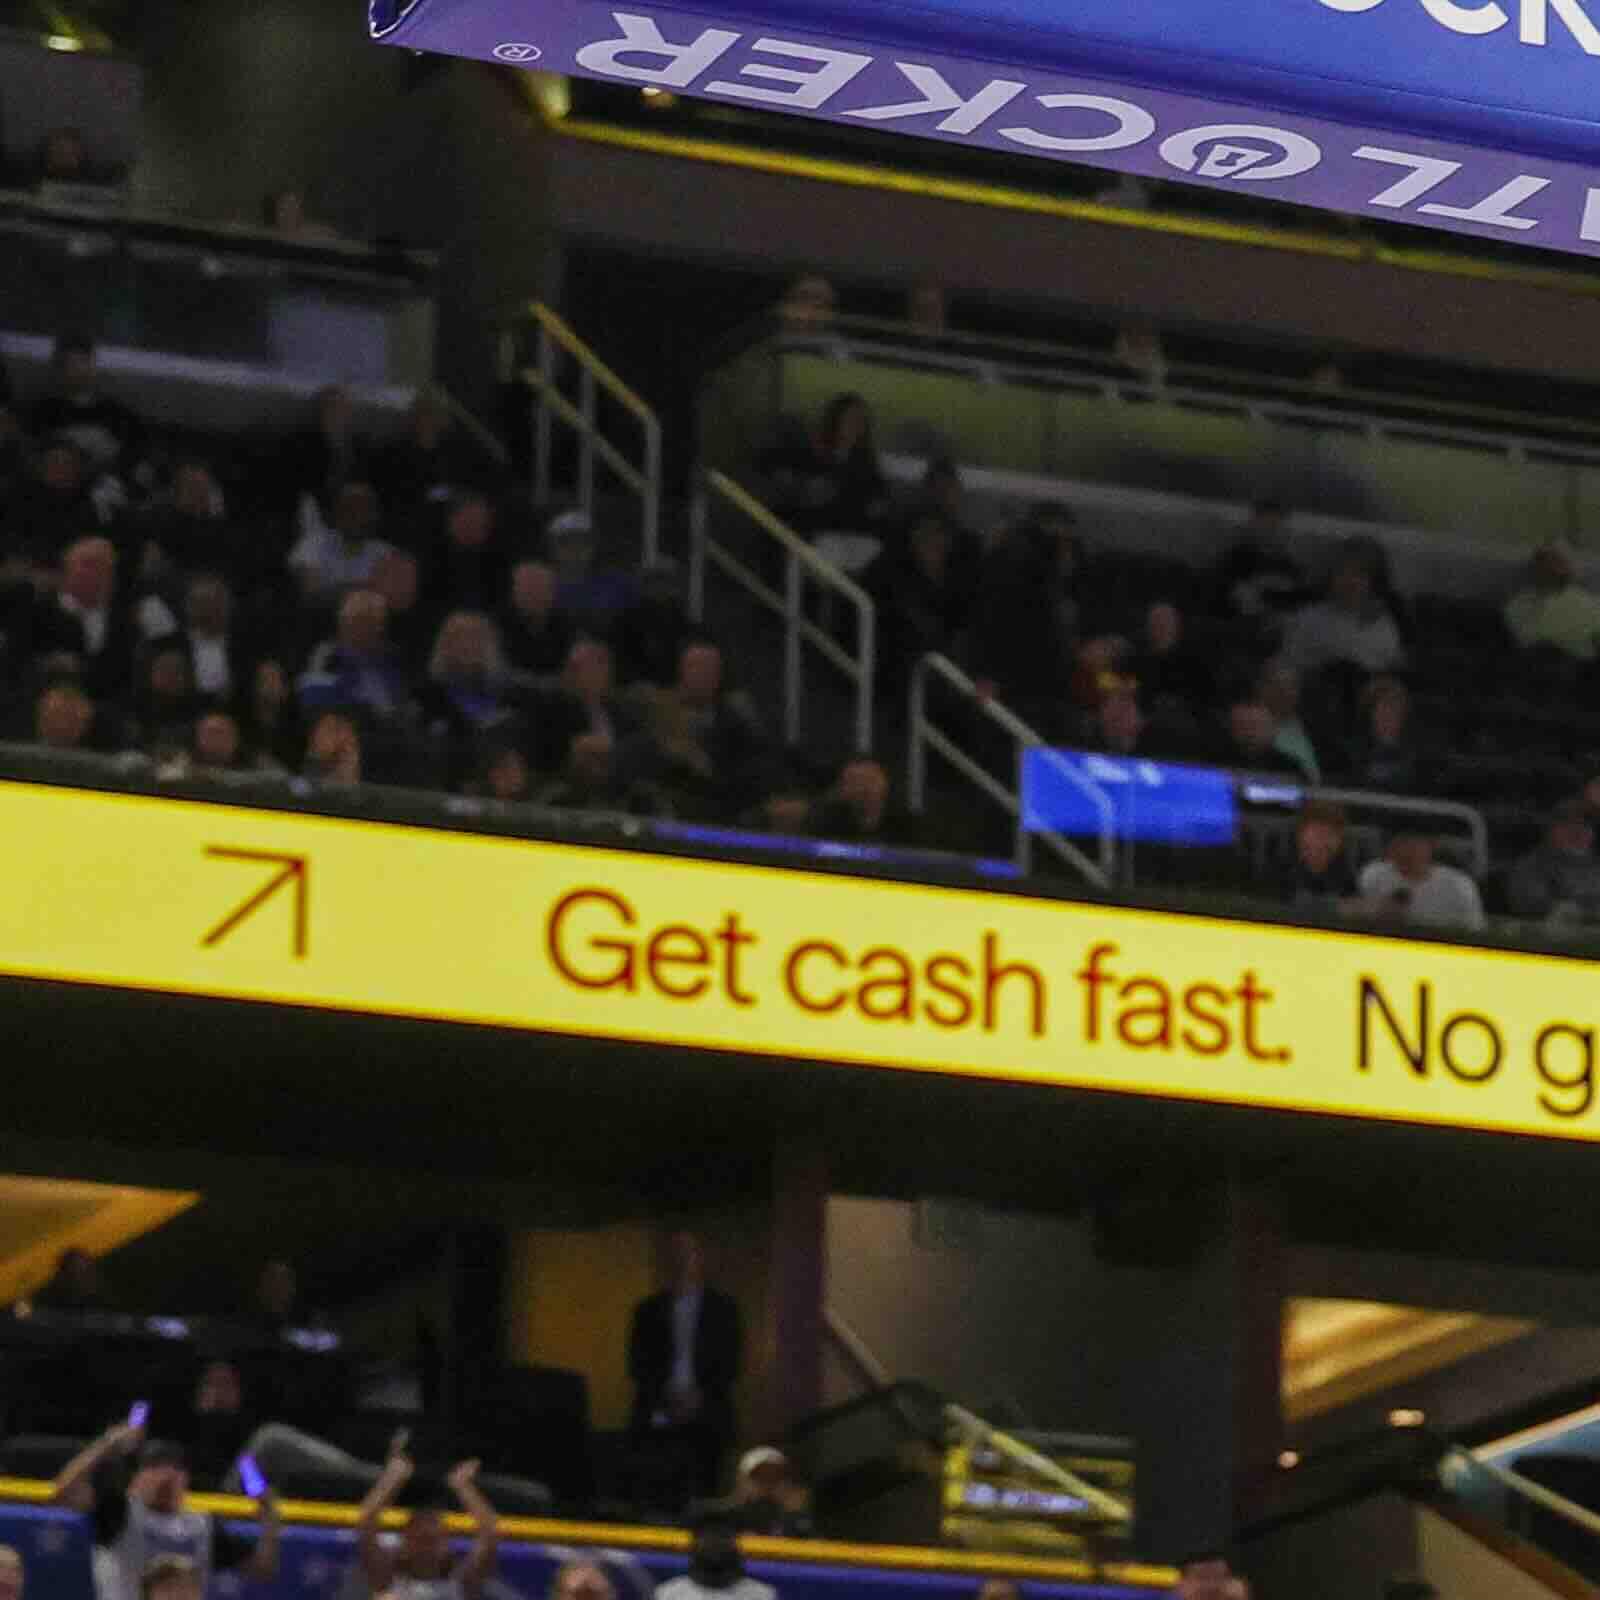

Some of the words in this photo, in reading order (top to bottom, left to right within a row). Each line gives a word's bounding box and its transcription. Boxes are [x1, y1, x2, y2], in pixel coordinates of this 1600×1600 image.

[546, 888, 755, 1005] Get
[784, 932, 1045, 1034] cash
[1074, 942, 1290, 1063] fast.
[1358, 974, 1502, 1082] No
